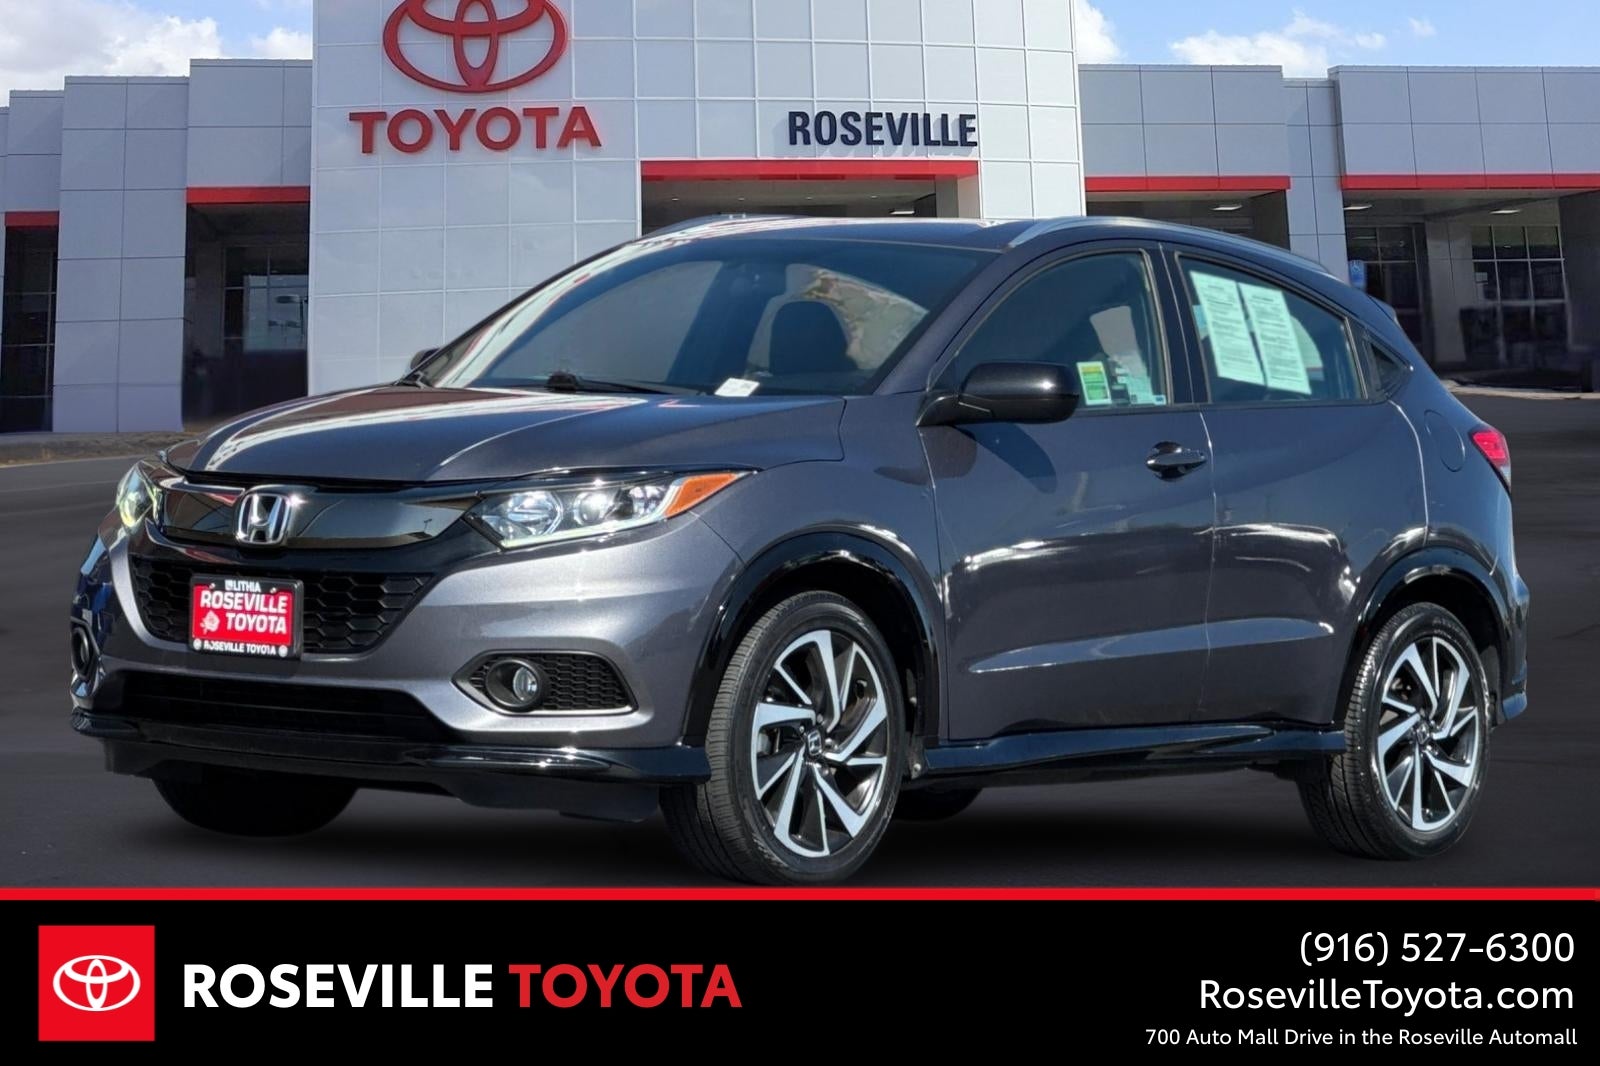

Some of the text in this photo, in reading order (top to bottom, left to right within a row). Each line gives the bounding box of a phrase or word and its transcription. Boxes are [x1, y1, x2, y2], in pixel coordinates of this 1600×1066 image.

[349, 106, 602, 154] TOYOTA
[788, 111, 978, 147] ROSEVILLE
[233, 580, 261, 593] LITHIA
[200, 590, 288, 614] ROSEVILLE
[225, 612, 287, 635] TOYOTA
[203, 641, 276, 655] ROSEVILLE TOYOTA
